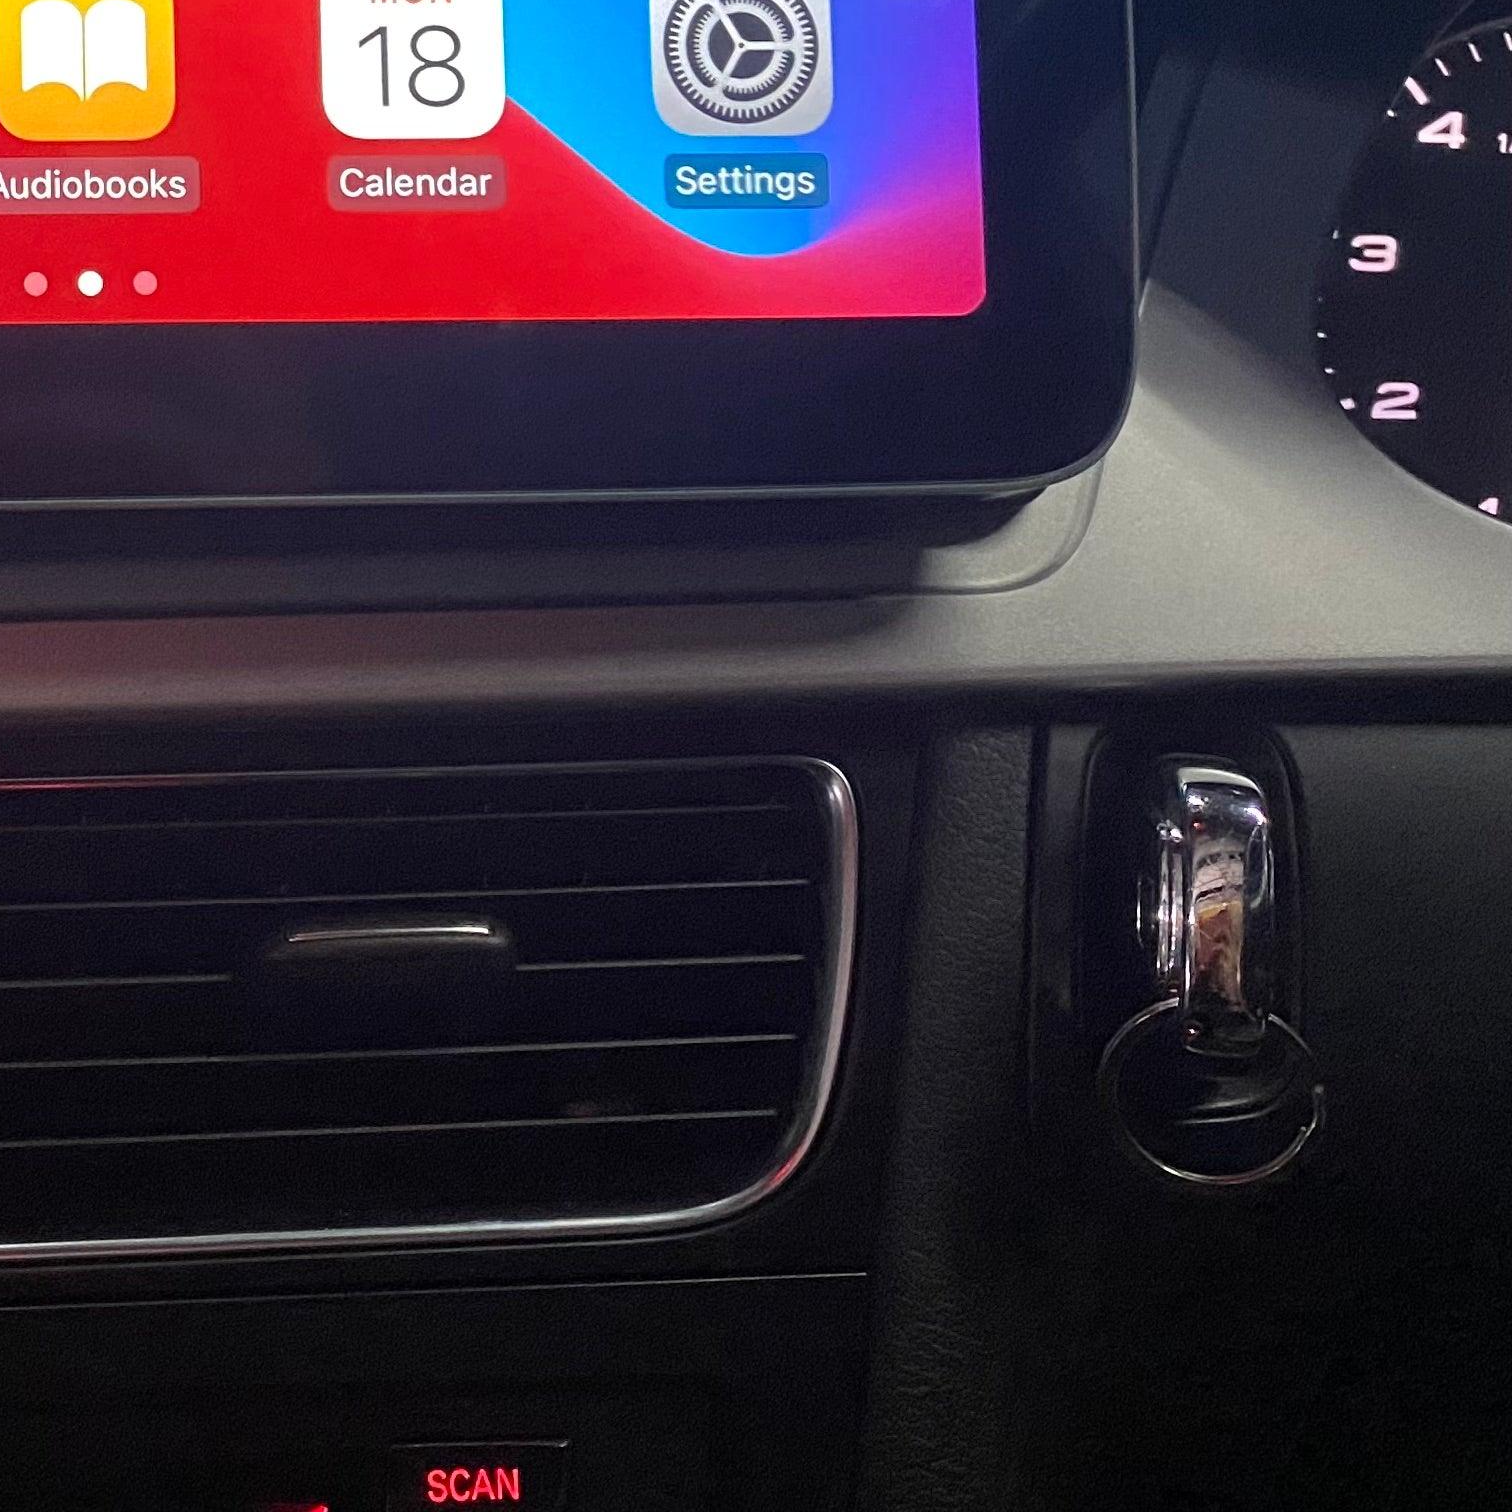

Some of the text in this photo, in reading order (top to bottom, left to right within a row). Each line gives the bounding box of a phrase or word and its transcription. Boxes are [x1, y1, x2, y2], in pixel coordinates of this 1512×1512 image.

[359, 25, 464, 107] 18
[1417, 112, 1465, 149] 4
[340, 167, 491, 197] Calendar
[677, 166, 814, 200] Settings
[1349, 235, 1397, 272] 3
[1371, 382, 1419, 419] 2
[428, 1469, 519, 1503] SCAN
